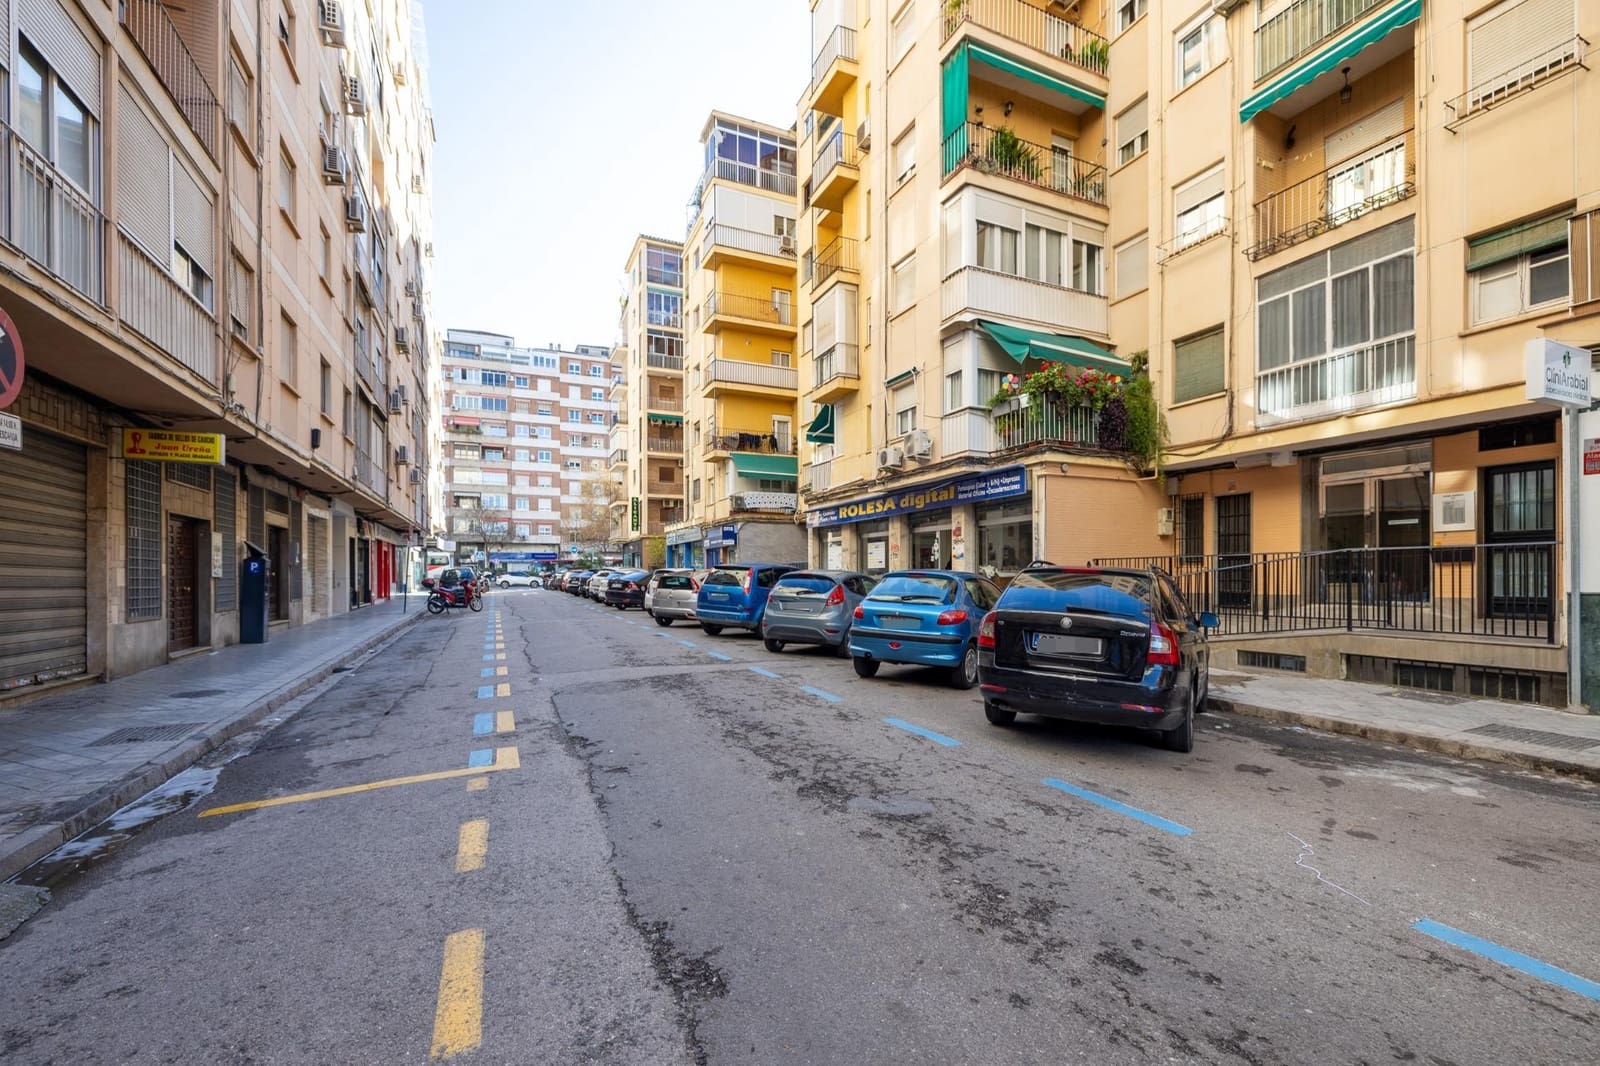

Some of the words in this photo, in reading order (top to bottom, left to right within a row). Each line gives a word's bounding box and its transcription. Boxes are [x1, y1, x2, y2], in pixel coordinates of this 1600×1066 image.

[154, 443, 178, 451] Juan
[839, 498, 896, 518] ROLESA
[900, 487, 954, 508] digital
[250, 562, 258, 571] P
